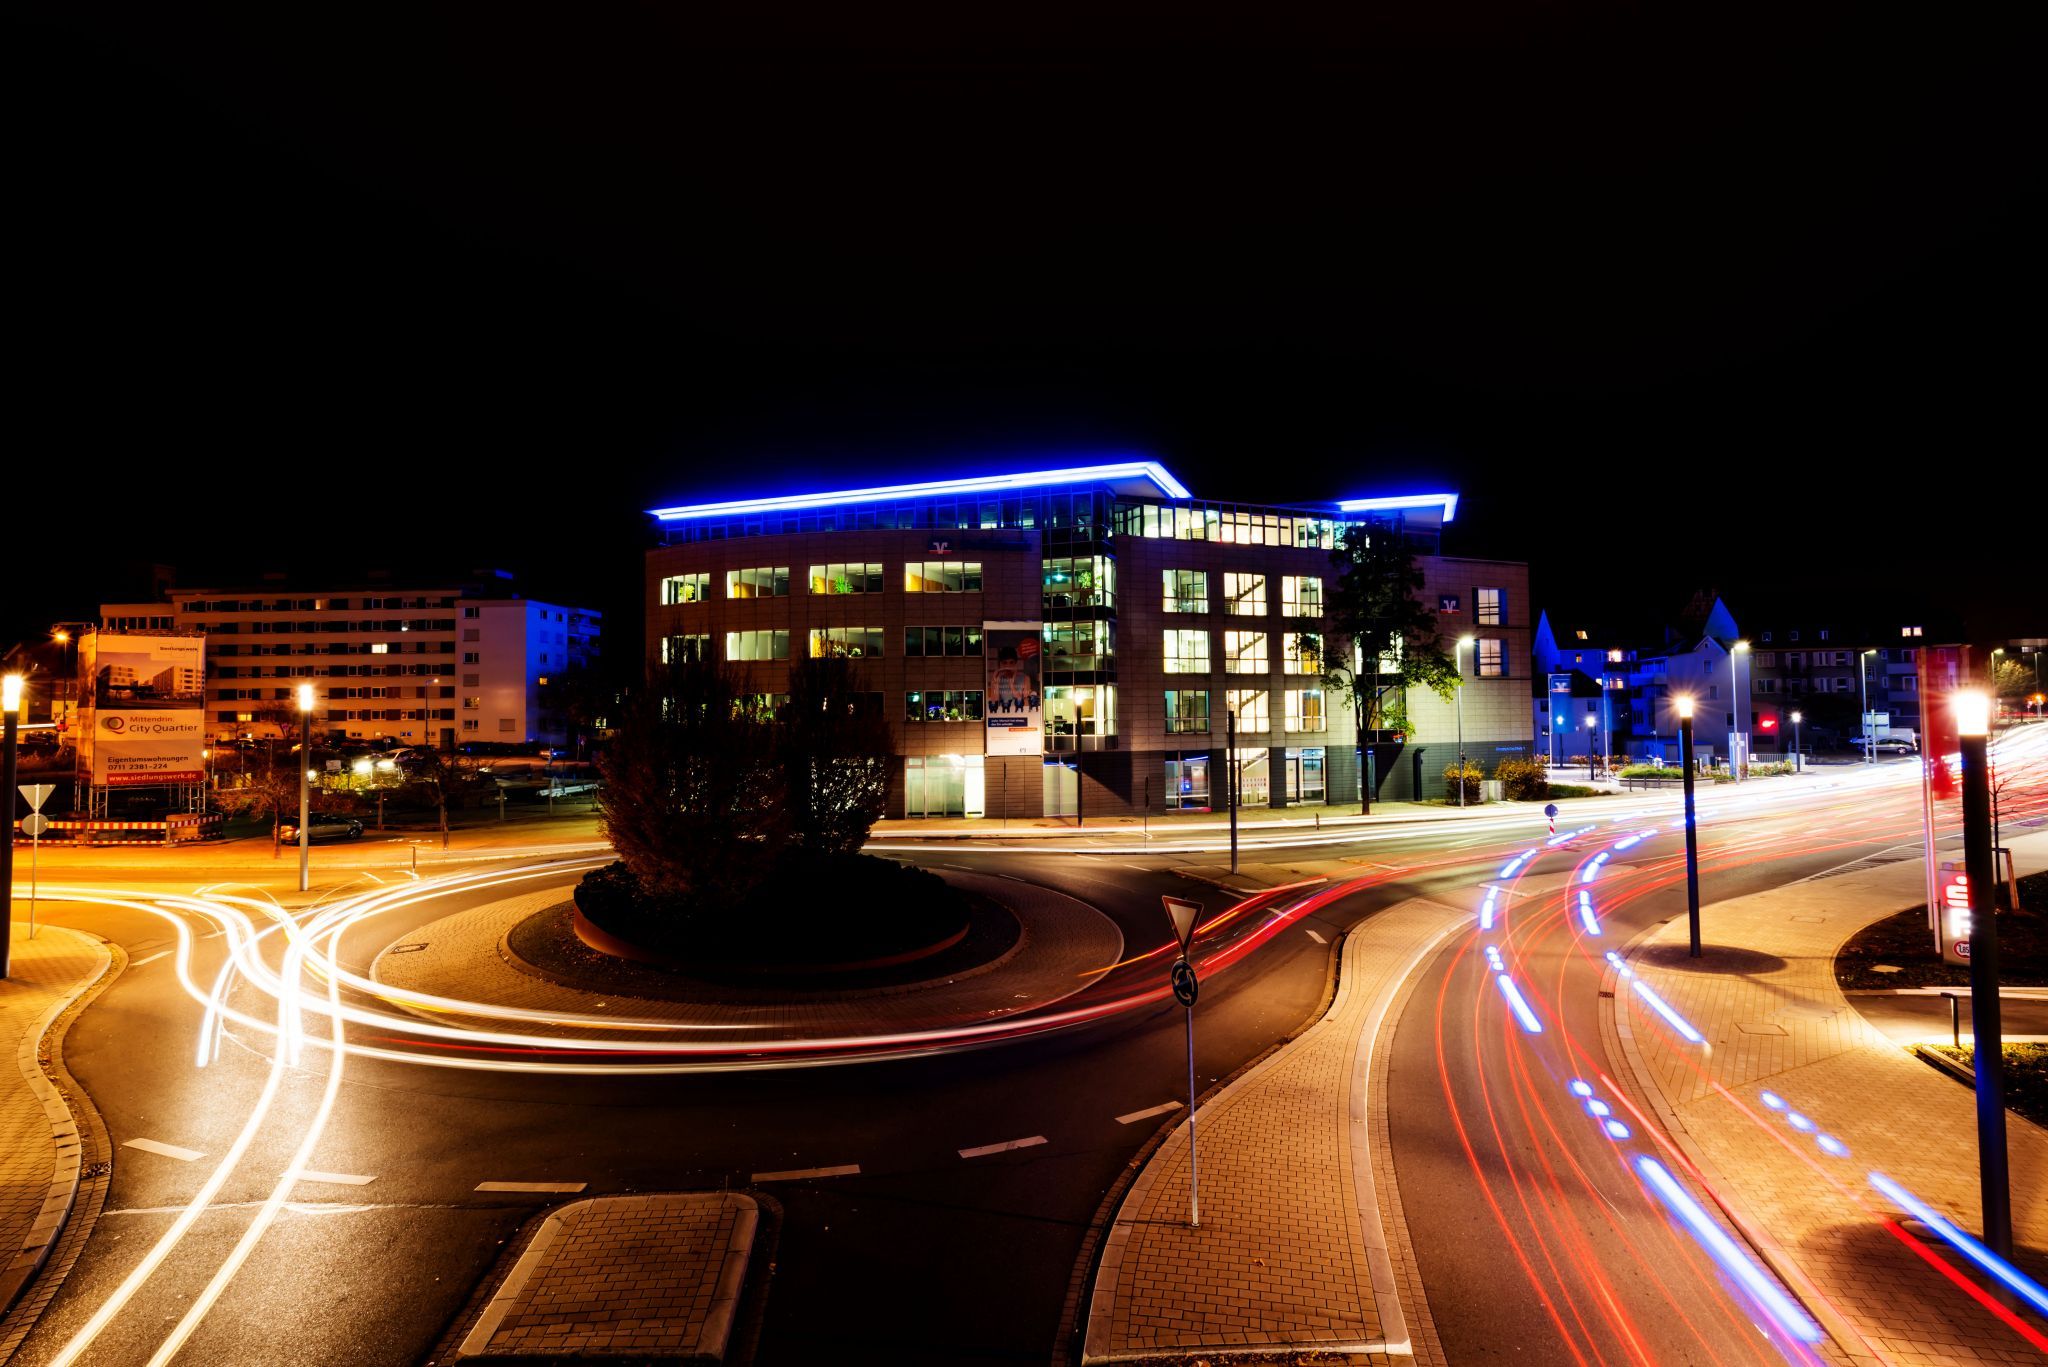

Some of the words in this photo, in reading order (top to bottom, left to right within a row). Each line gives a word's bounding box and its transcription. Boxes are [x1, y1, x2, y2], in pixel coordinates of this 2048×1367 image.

[129, 725, 150, 734] City
[153, 724, 198, 733] Quartier
[107, 756, 189, 764] Eigentumswohnungen
[109, 773, 197, 782] www.siedlungswerk.de
